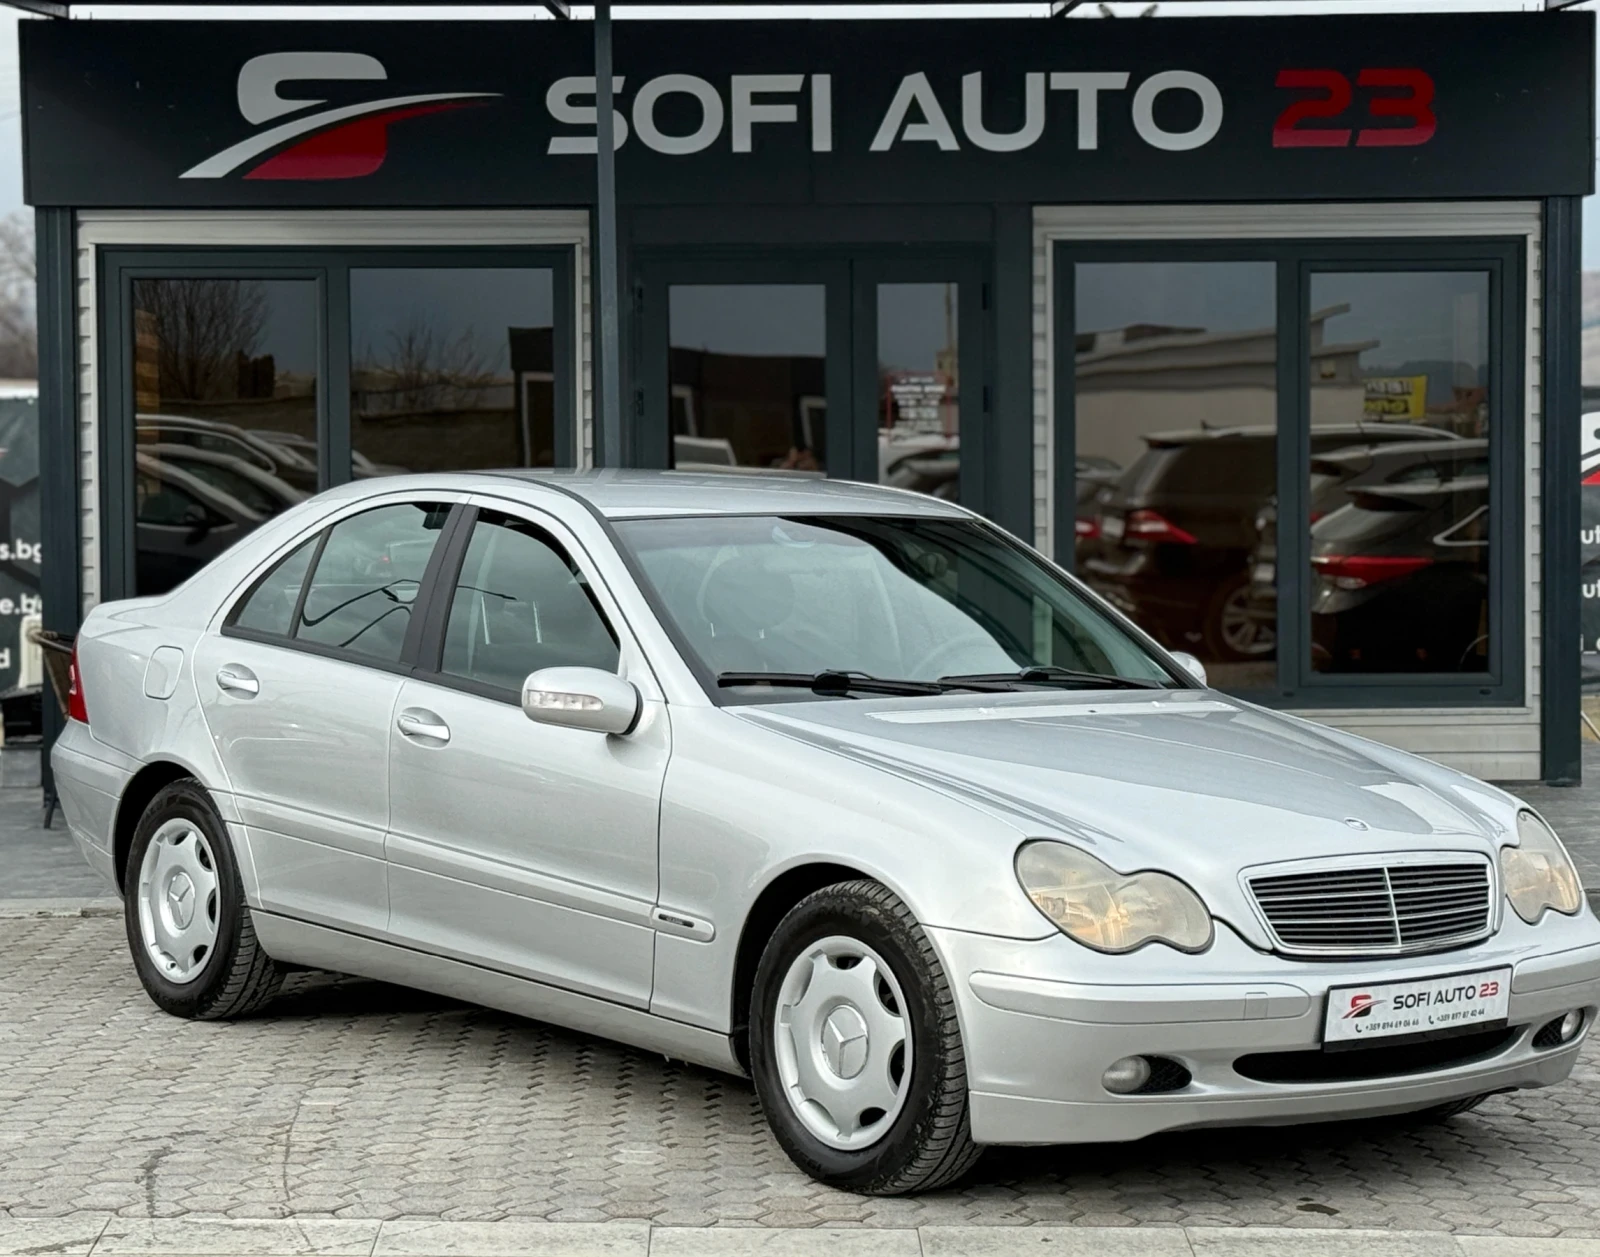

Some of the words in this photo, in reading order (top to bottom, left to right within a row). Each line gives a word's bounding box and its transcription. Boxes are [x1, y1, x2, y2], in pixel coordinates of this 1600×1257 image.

[547, 71, 832, 155] SOFI
[870, 70, 1223, 152] AUTO
[1272, 68, 1437, 149] 23
[1393, 991, 1431, 1010] SOFI
[1433, 985, 1477, 1005] AUTO
[1479, 982, 1500, 998] 23
